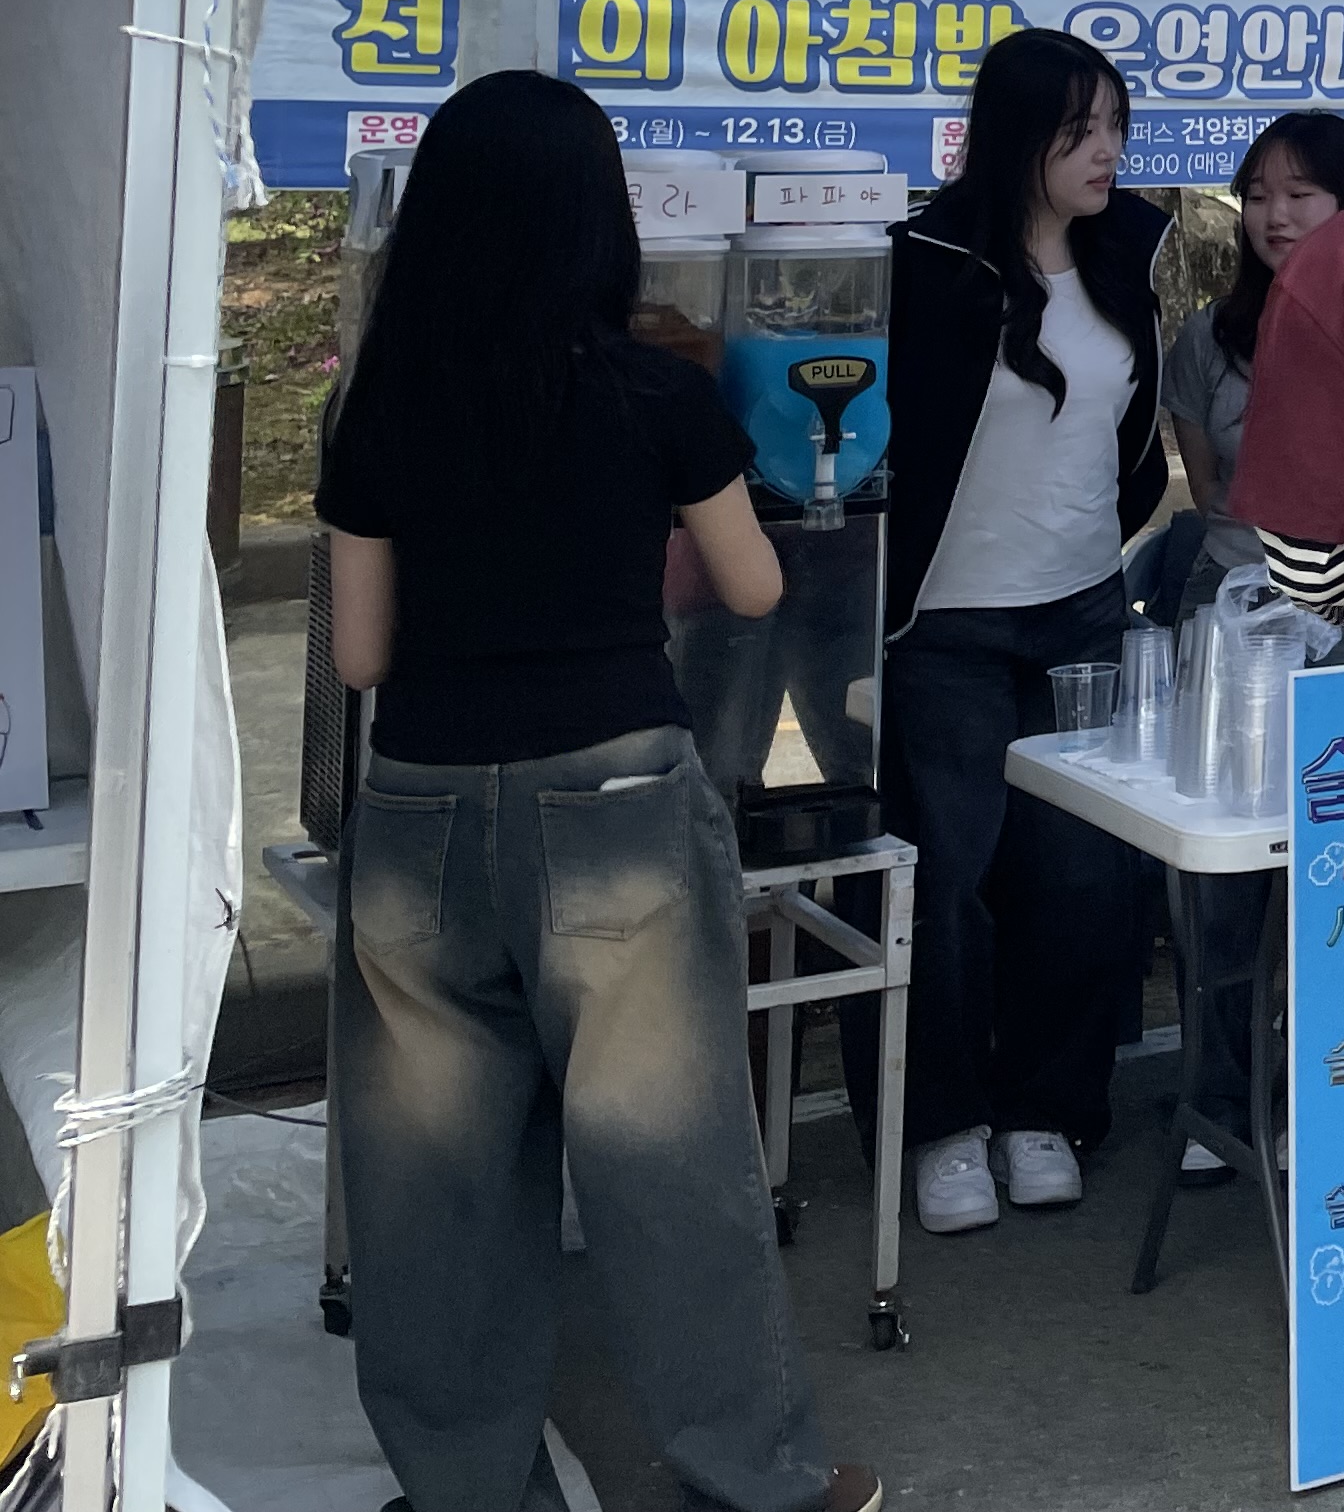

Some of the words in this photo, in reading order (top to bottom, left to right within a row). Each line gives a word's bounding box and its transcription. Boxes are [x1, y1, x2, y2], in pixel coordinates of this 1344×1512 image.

[358, 115, 419, 145] 운영
[720, 117, 857, 150] 12.13.(금)
[811, 363, 857, 380] PULL
